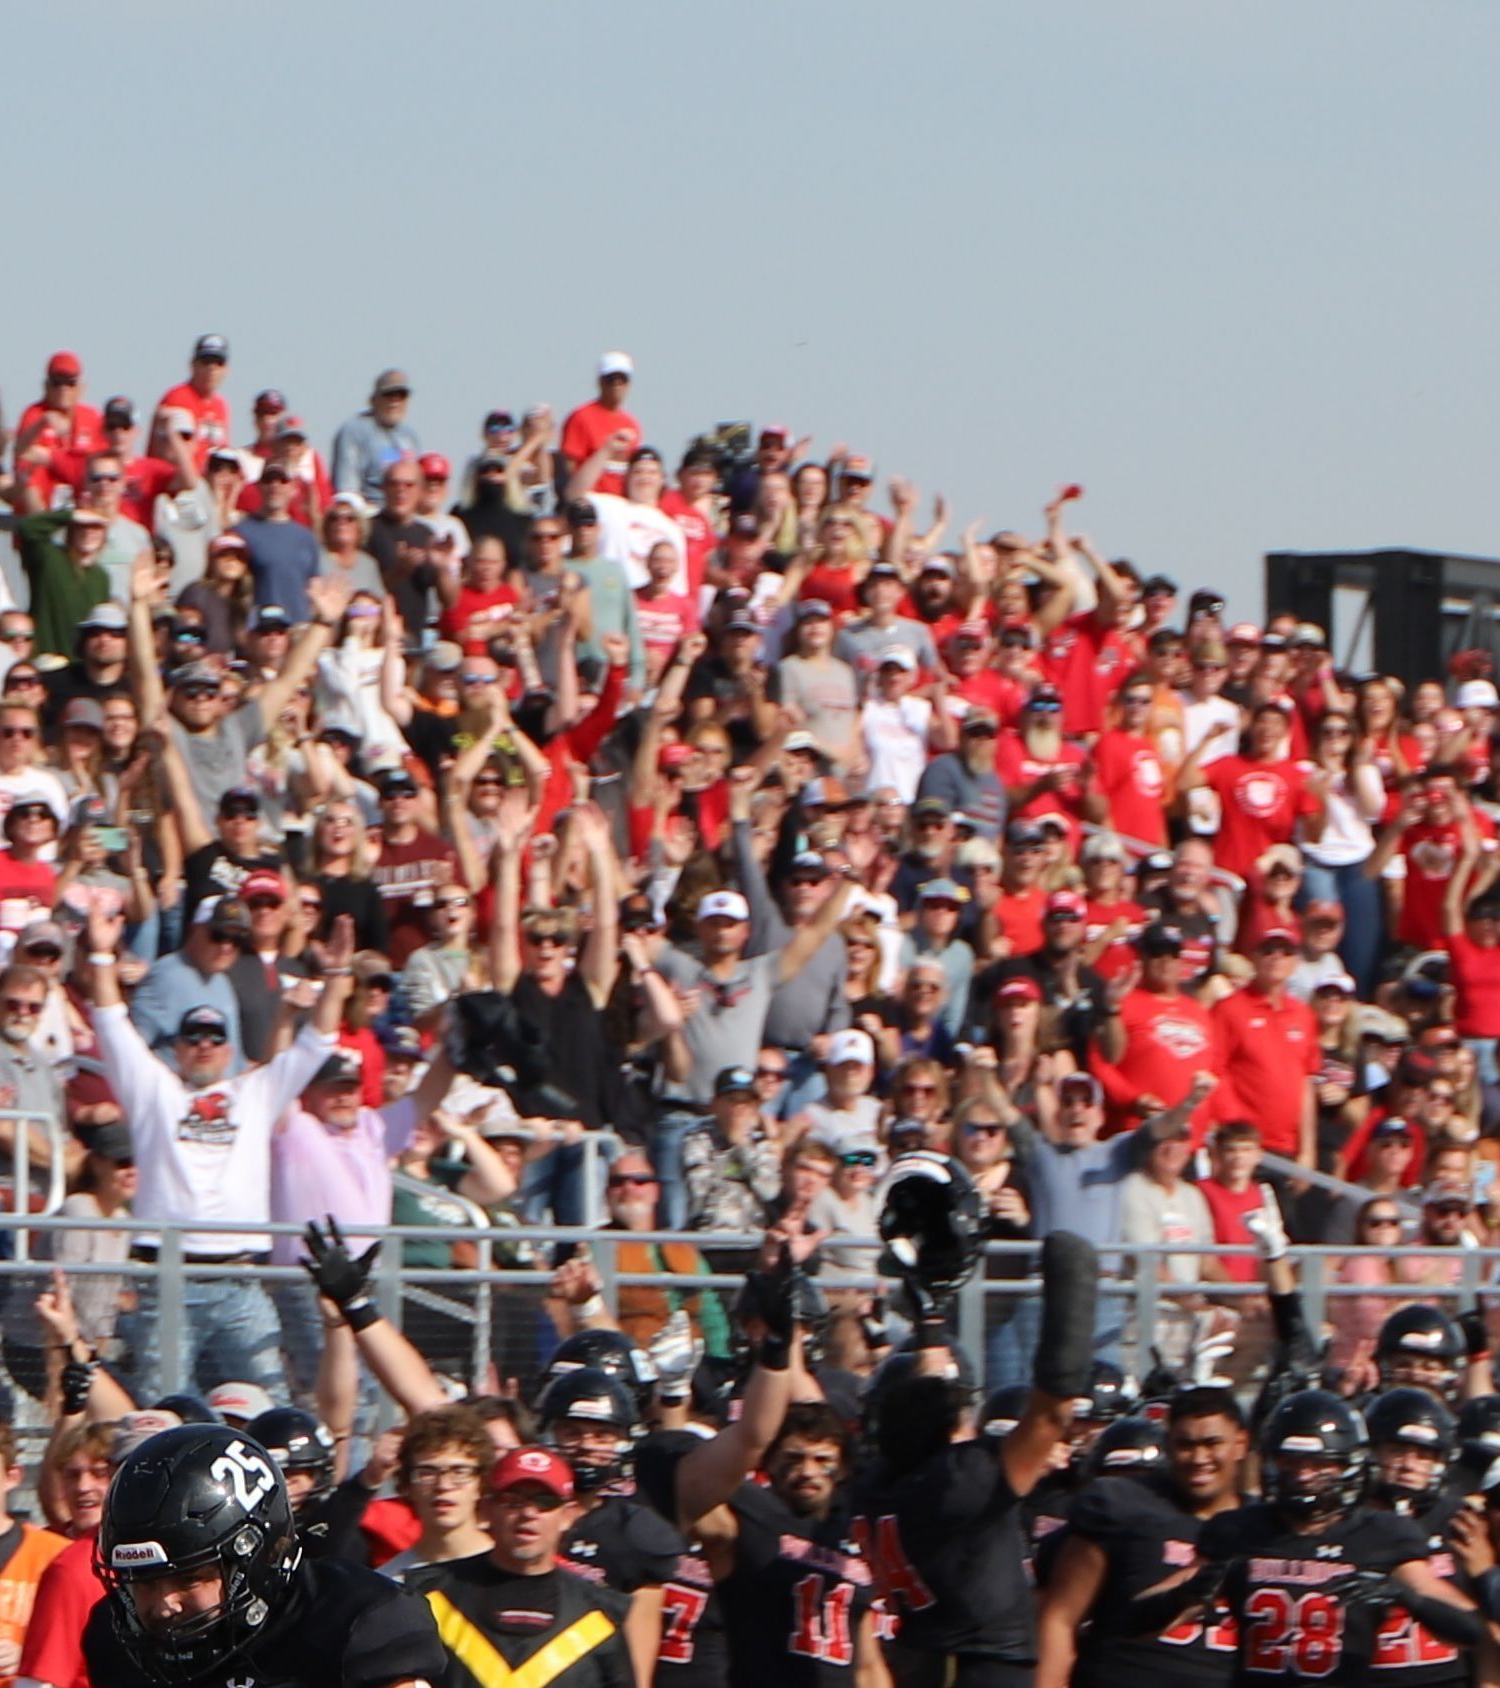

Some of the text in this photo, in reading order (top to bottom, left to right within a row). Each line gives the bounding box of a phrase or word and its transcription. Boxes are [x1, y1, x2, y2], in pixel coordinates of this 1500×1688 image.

[211, 1440, 275, 1512] 25
[115, 1547, 155, 1560] Riddell
[1244, 1588, 1346, 1677] 28
